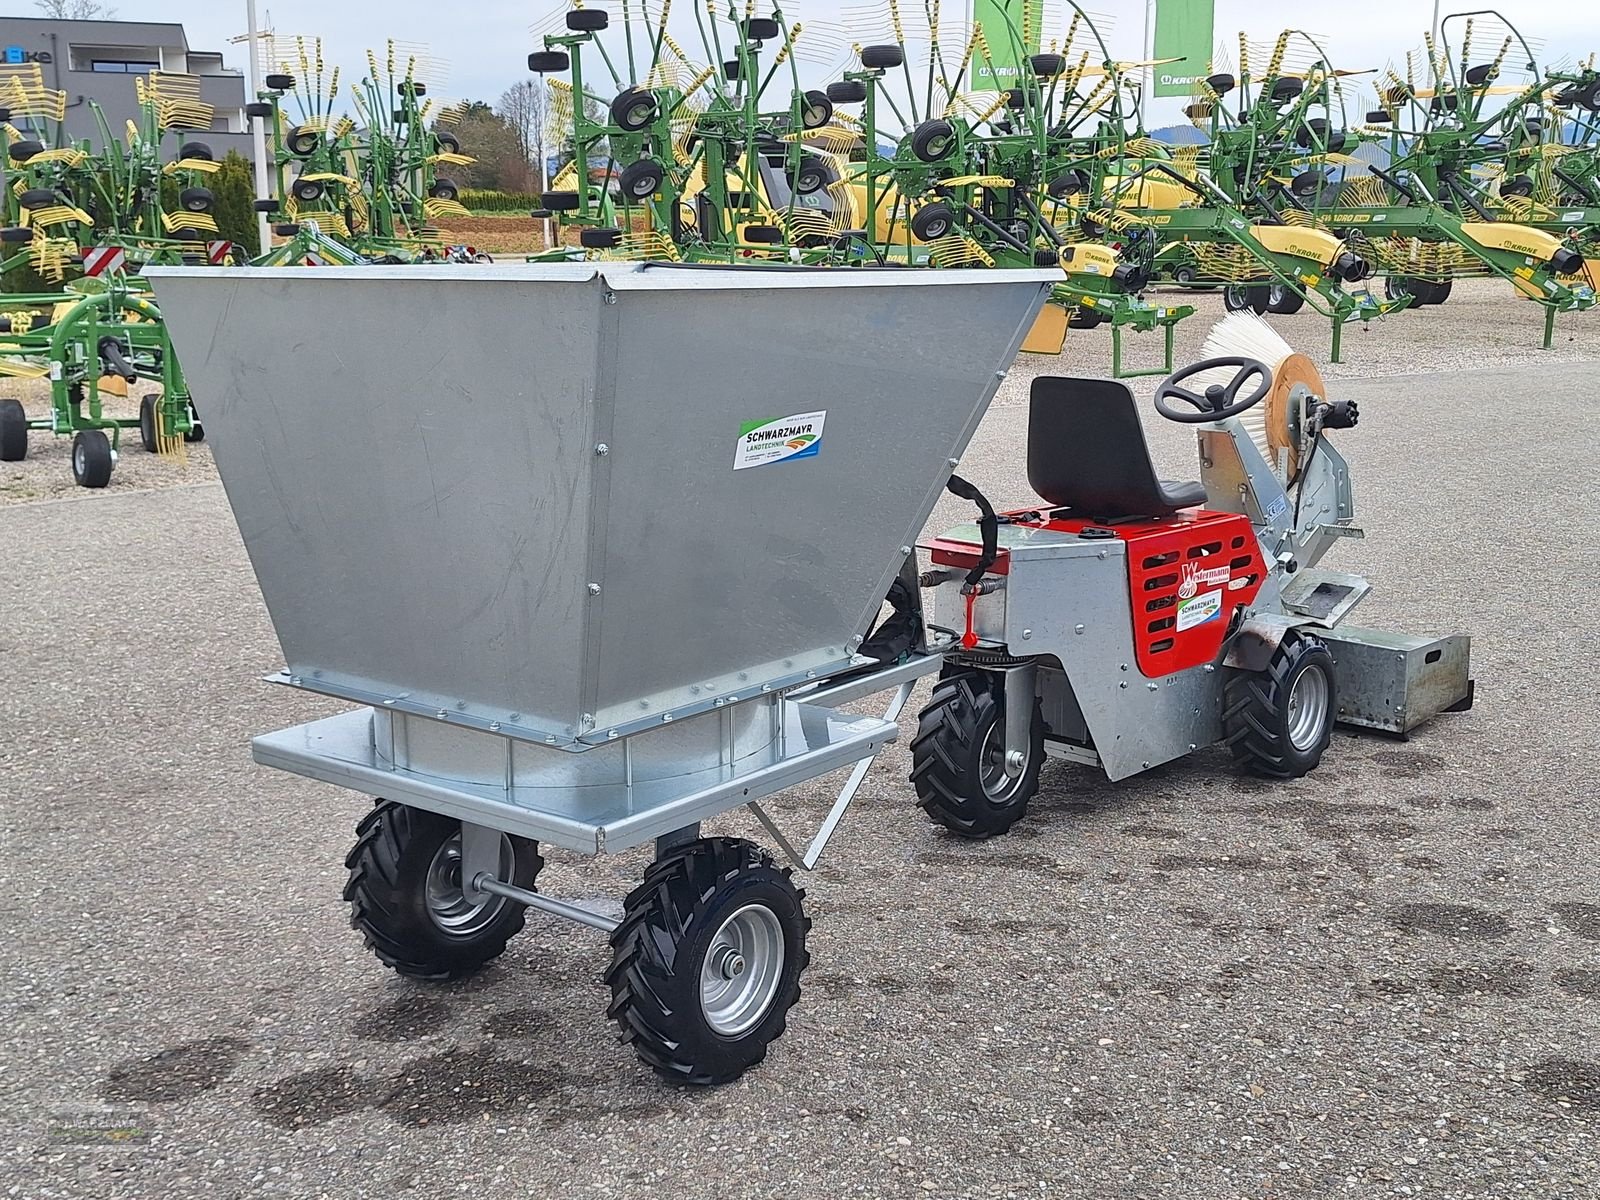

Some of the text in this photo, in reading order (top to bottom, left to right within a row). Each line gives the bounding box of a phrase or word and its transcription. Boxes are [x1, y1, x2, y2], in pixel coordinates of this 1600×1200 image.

[1296, 248, 1323, 260] KRONE
[1511, 244, 1538, 255] KRONE
[1090, 254, 1110, 264] KRONE
[746, 424, 813, 443] SCHWARZMAYR
[746, 440, 785, 453] LANDTECHNIK
